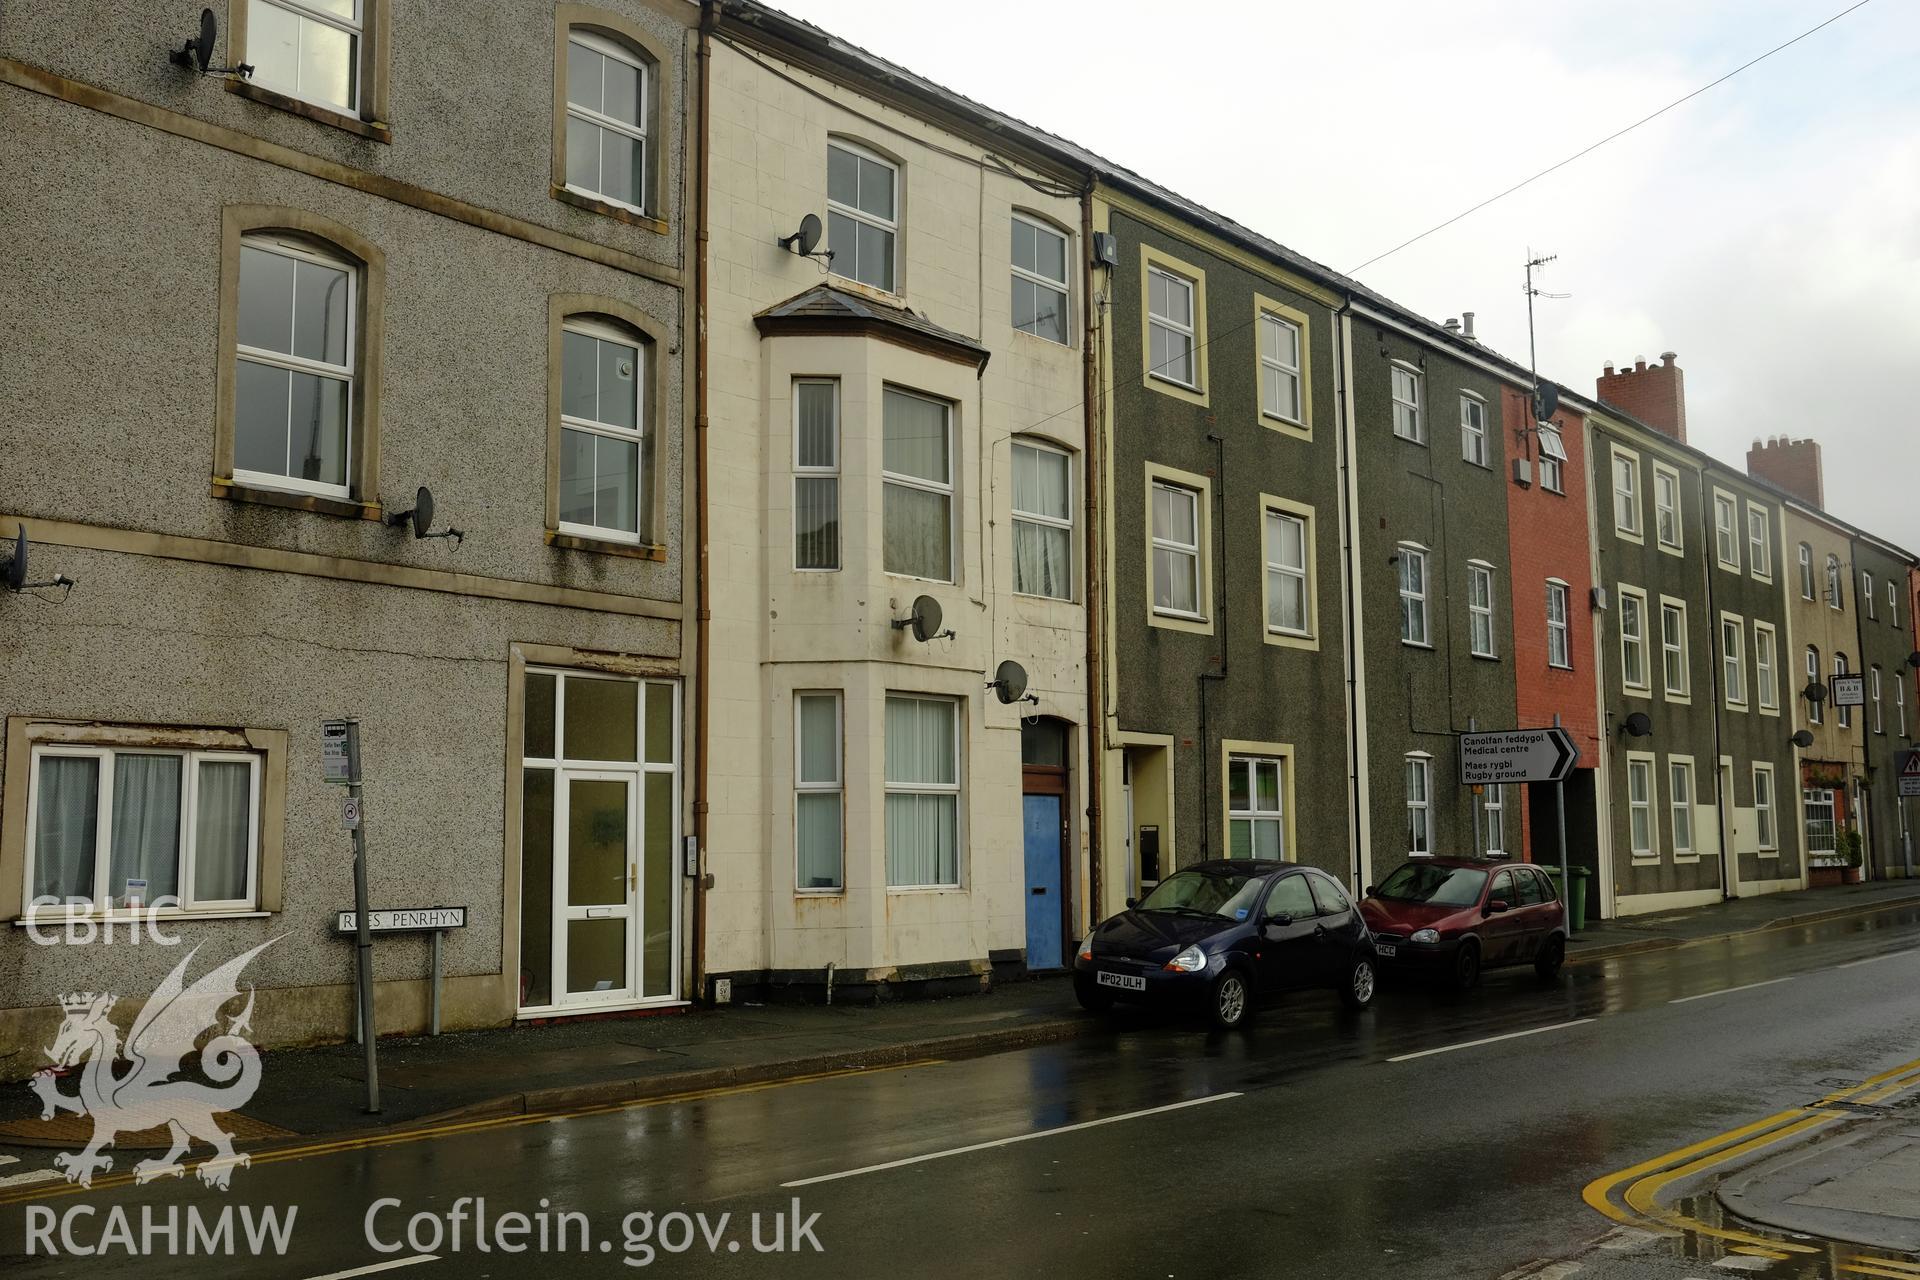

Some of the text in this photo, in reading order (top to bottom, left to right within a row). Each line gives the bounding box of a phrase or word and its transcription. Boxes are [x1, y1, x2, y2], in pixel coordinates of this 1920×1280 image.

[1464, 734, 1544, 746] Canolfan feddygol
[1464, 745, 1529, 755] Medical centre
[1465, 760, 1513, 770] Maes rygbi
[1465, 769, 1527, 781] Rugby ground
[343, 911, 460, 928] RES PENRHYN
[1100, 972, 1142, 989] WP02 ULH
